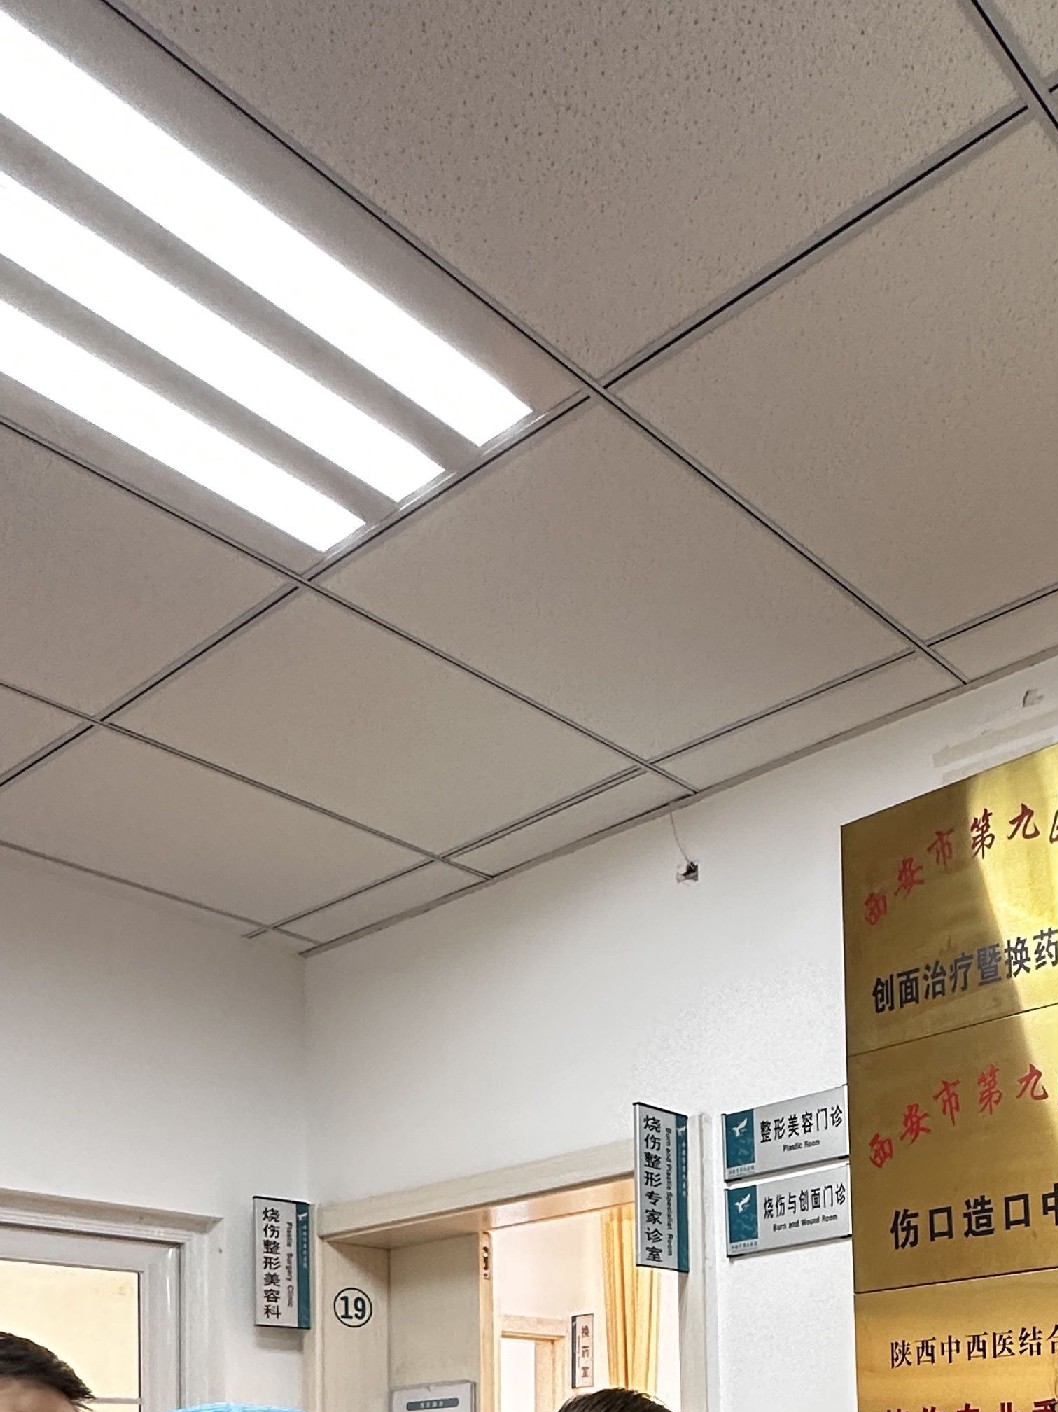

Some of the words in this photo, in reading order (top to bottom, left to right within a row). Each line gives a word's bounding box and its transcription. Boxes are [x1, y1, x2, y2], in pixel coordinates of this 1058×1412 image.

[760, 1104, 843, 1144] 整形美容门诊
[782, 1141, 803, 1152] Plastic
[803, 1140, 820, 1149] Room
[643, 1115, 663, 1263] 烧伤整形专家诊室
[763, 1183, 846, 1219] 烧伤与创面门诊
[788, 1220, 800, 1229] and
[821, 1214, 838, 1222] Room
[262, 1207, 281, 1319] 烧伤整形美容科
[340, 1295, 367, 1320] 19
